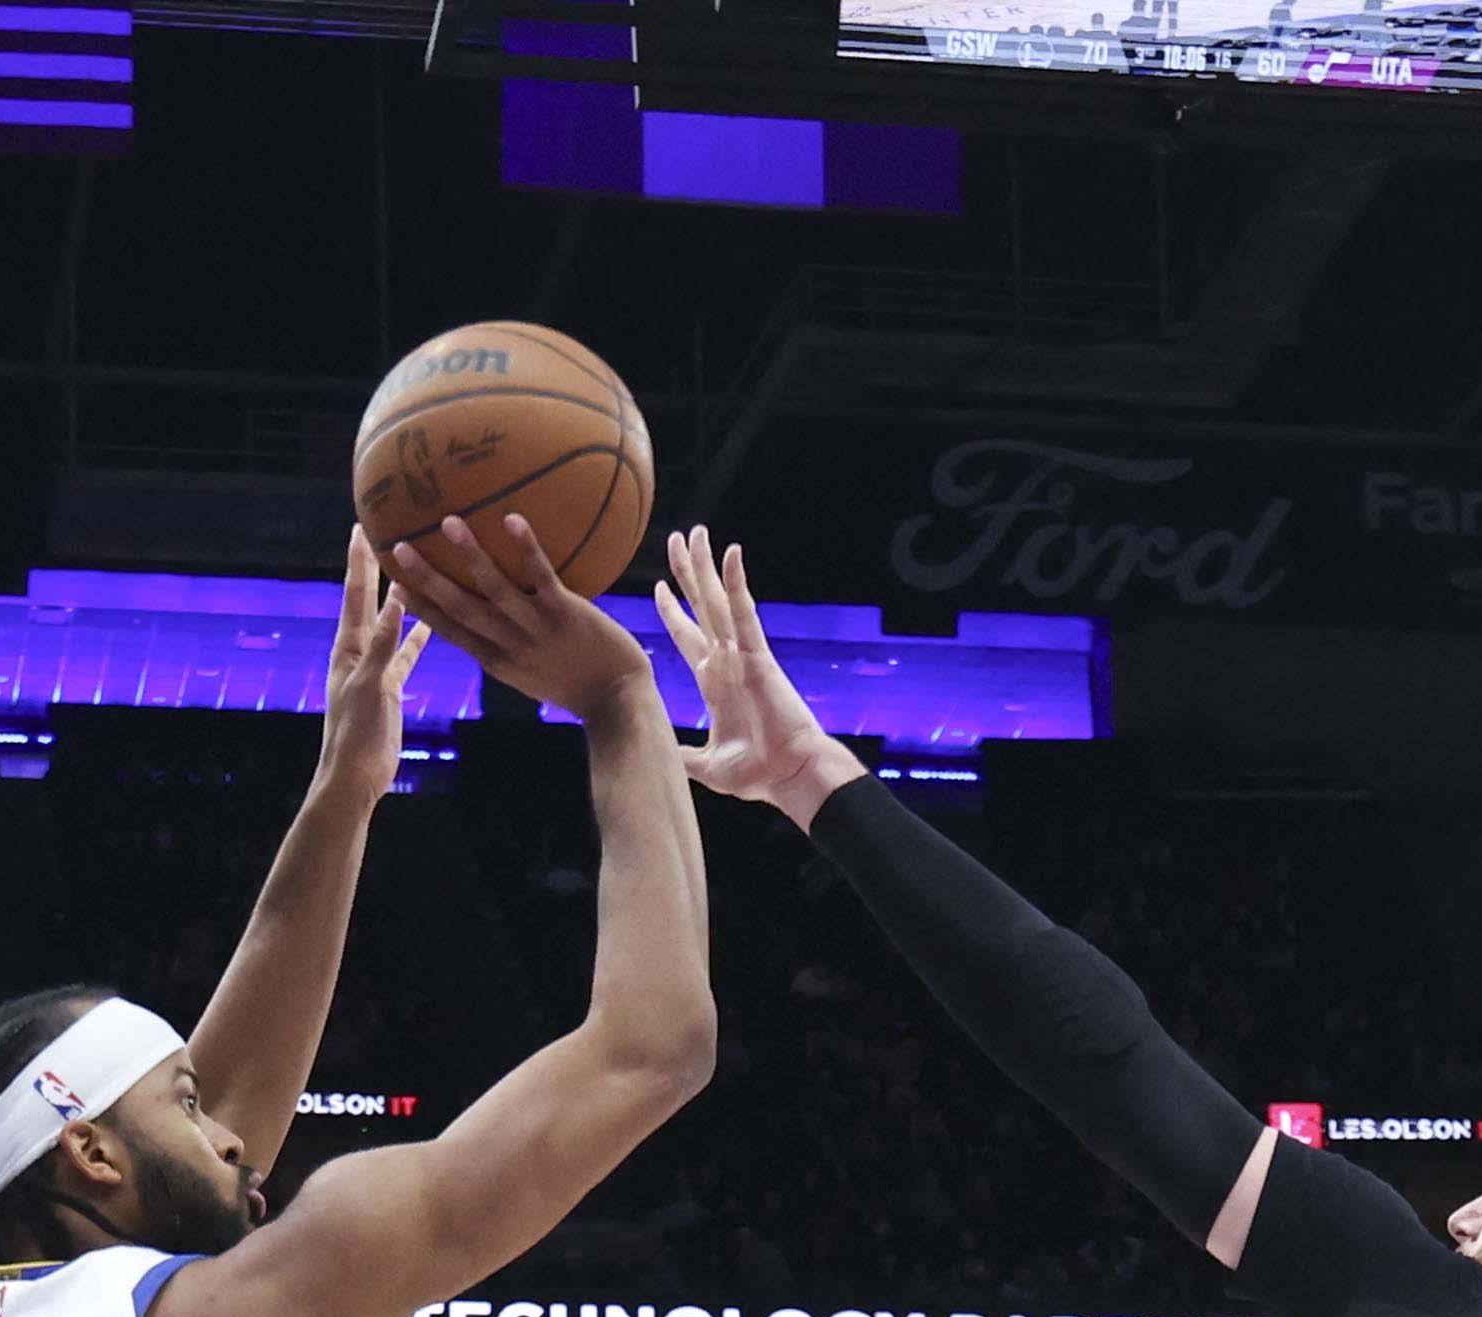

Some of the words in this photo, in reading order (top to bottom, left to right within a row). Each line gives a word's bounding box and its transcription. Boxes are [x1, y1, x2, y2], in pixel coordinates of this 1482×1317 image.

[945, 29, 1000, 58] GSW
[1080, 40, 1110, 66] 70
[1256, 51, 1288, 78] 60
[1370, 55, 1415, 86] UTA
[890, 438, 1293, 606] Ford
[296, 1092, 386, 1116] OLSON
[391, 1096, 417, 1116] IT
